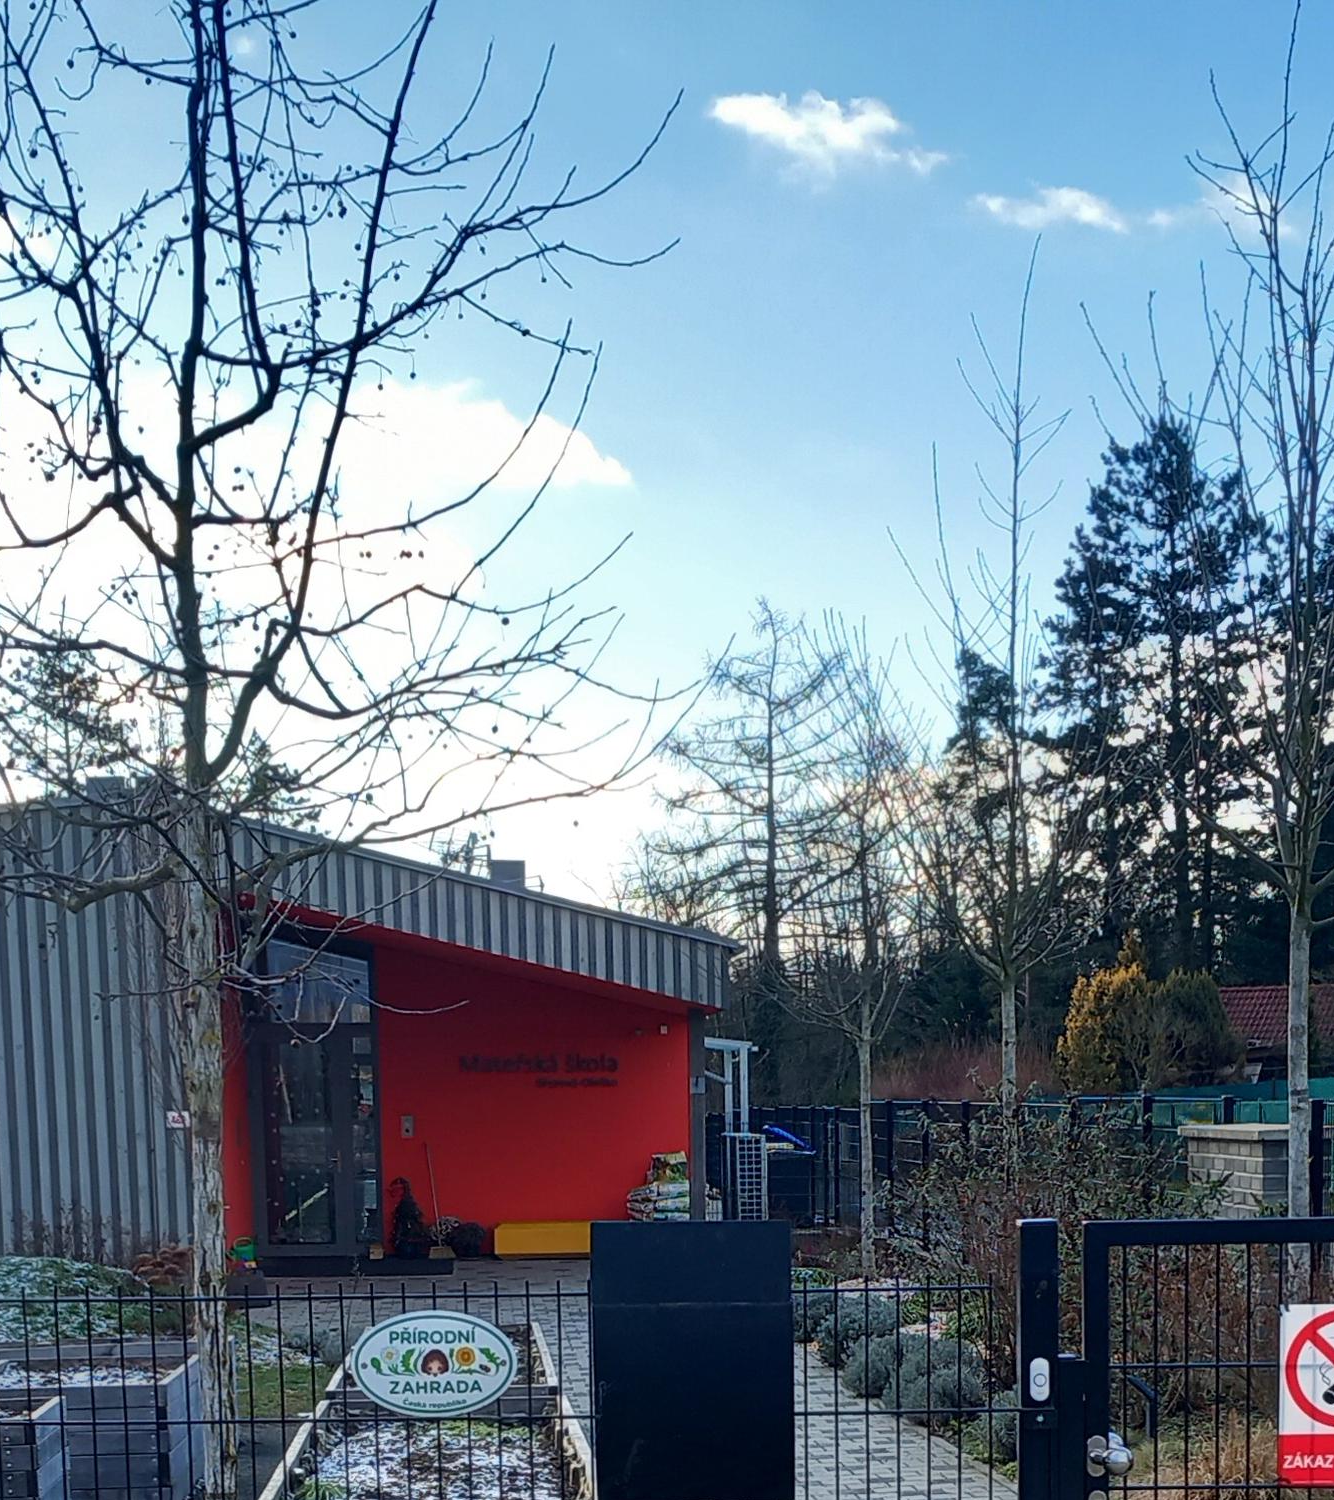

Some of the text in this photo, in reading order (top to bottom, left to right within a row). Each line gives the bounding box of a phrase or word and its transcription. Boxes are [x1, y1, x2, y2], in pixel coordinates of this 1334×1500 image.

[389, 1325, 476, 1345] PŘÍRODNÍ
[389, 1379, 483, 1395] ZAHRADA
[428, 1398, 467, 1409] republika
[1282, 1451, 1334, 1469] ZÁKAZ
